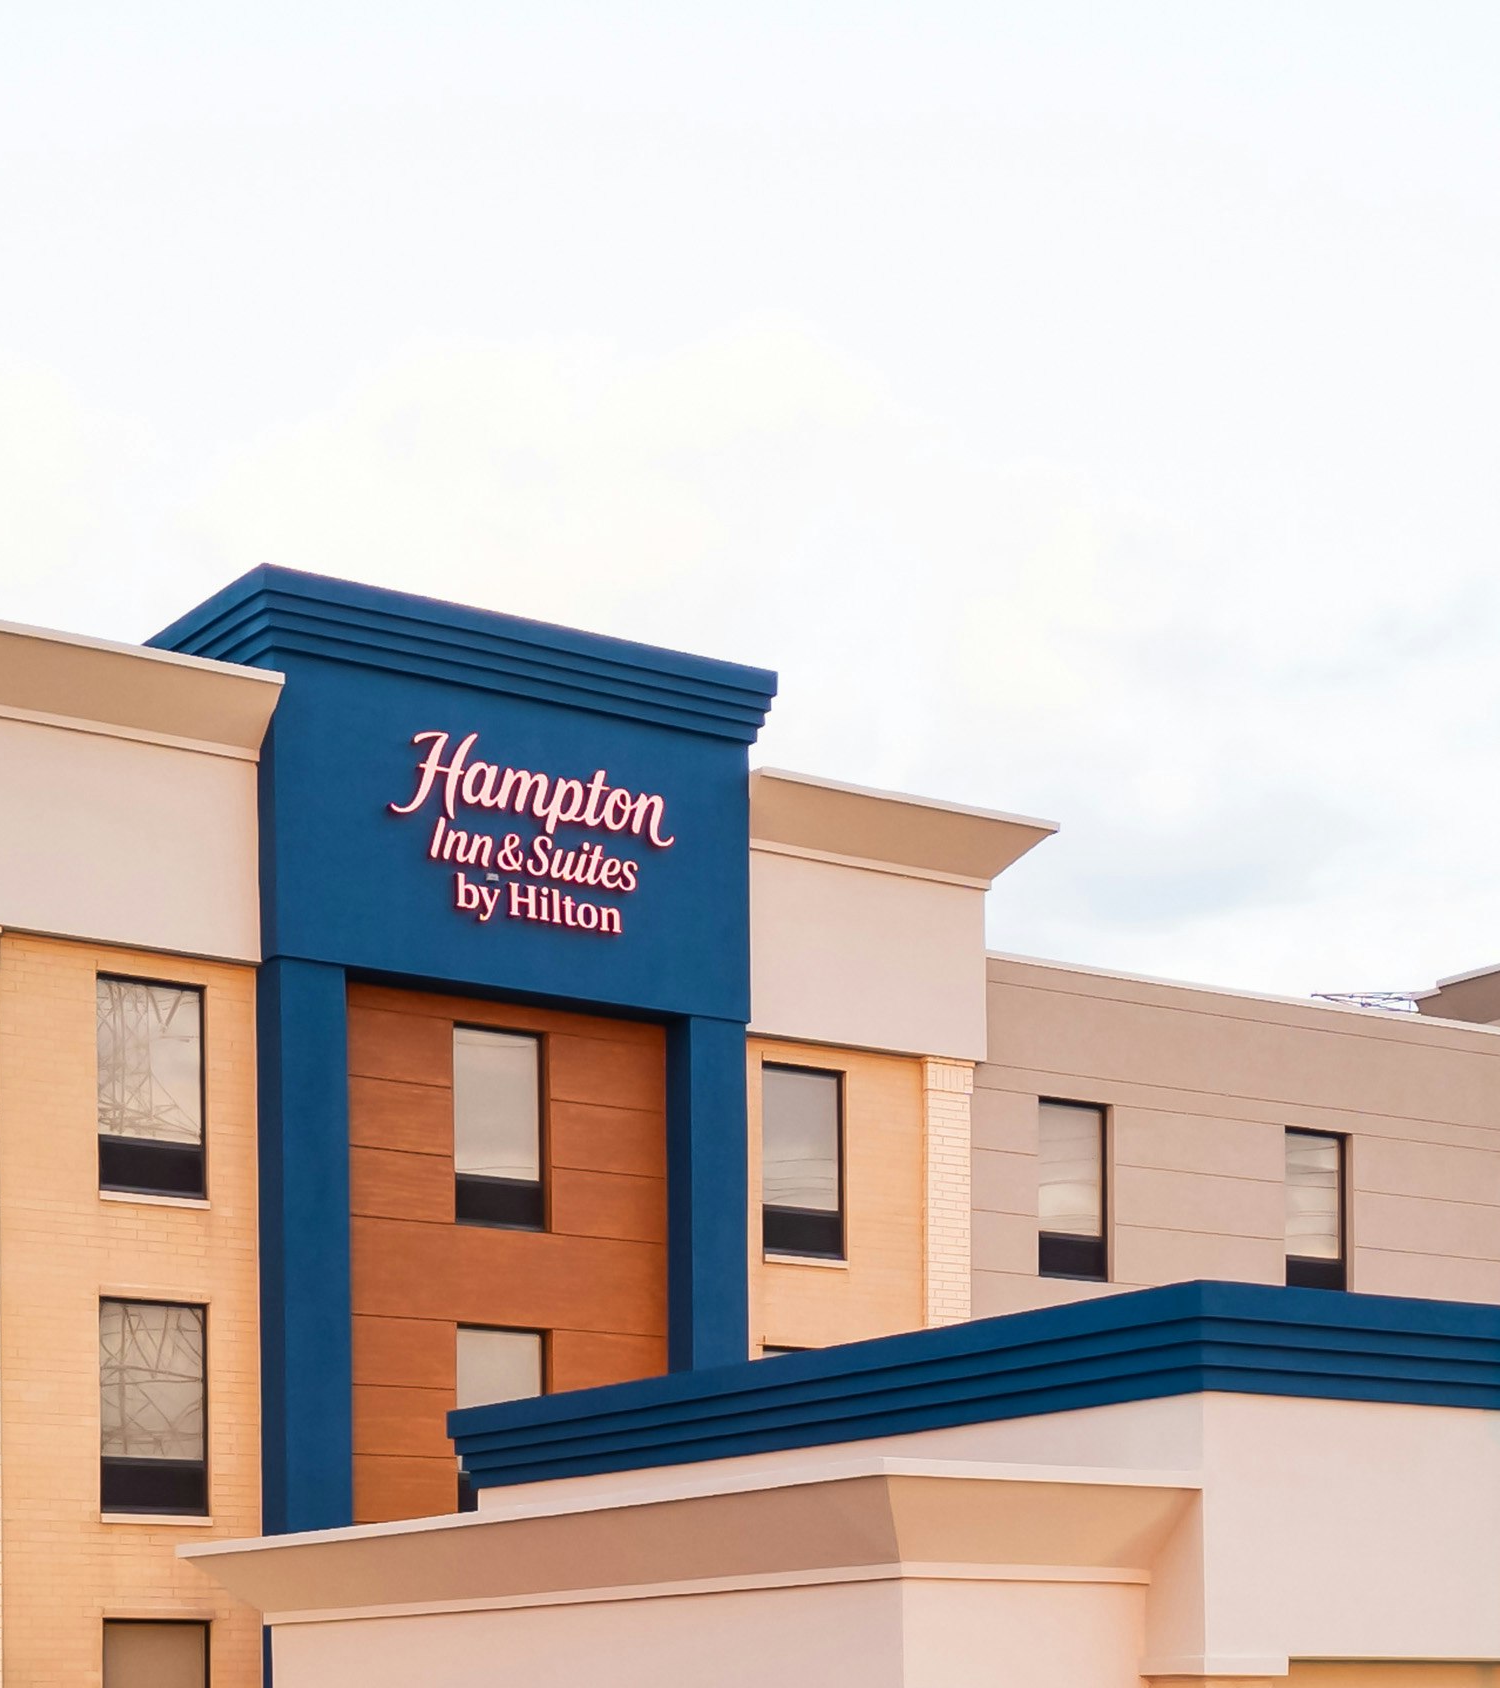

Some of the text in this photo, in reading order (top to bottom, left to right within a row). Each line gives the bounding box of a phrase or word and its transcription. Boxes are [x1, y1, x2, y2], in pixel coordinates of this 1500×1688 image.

[389, 731, 675, 847] Hampton
[429, 816, 639, 892] Inn & Suites
[456, 872, 622, 933] by Hilton
